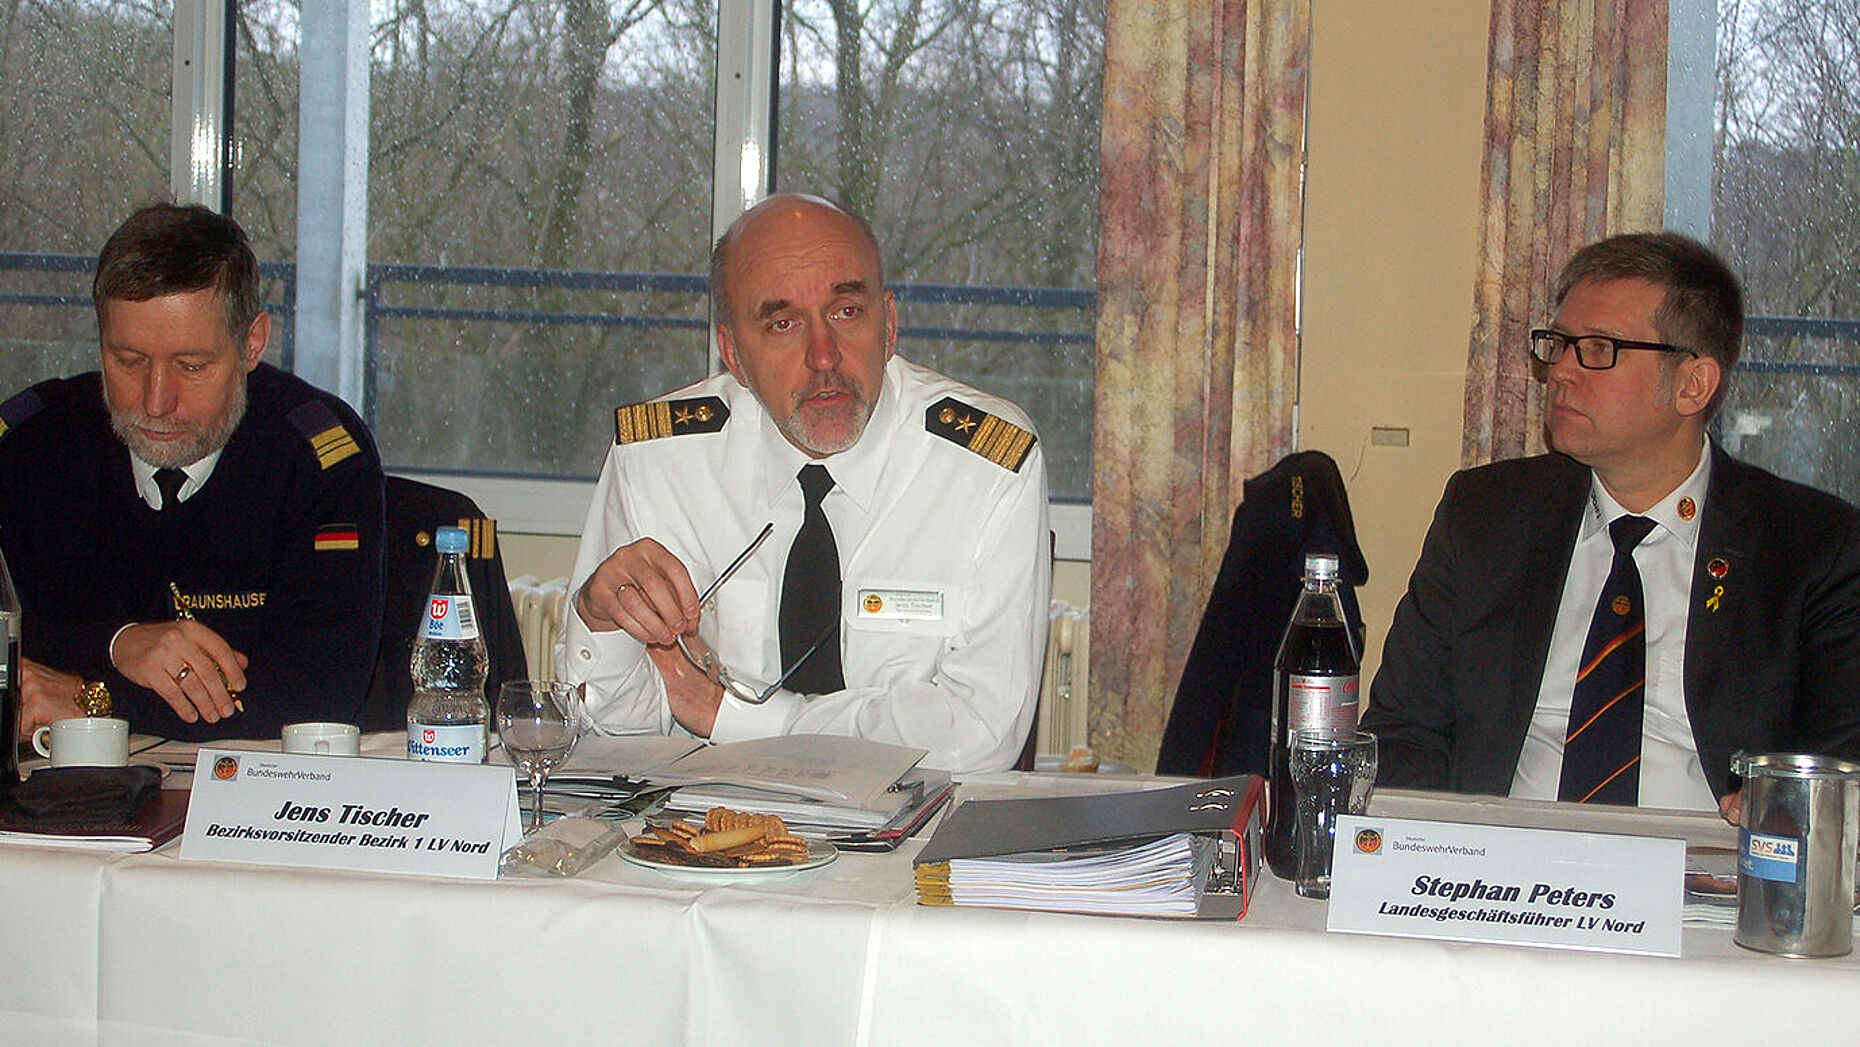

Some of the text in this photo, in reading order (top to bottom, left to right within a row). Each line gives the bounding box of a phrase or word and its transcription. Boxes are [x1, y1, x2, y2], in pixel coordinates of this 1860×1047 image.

[274, 800, 429, 828] Jens Tischer
[206, 823, 491, 854] Bezirksvorsitzender Bezirk 1 LV Nord
[1392, 841, 1486, 856] BundeswehrVerband
[1411, 875, 1616, 909] Stephan Peters
[1378, 901, 1645, 933] Landesgeschäftsführer LV Nord
